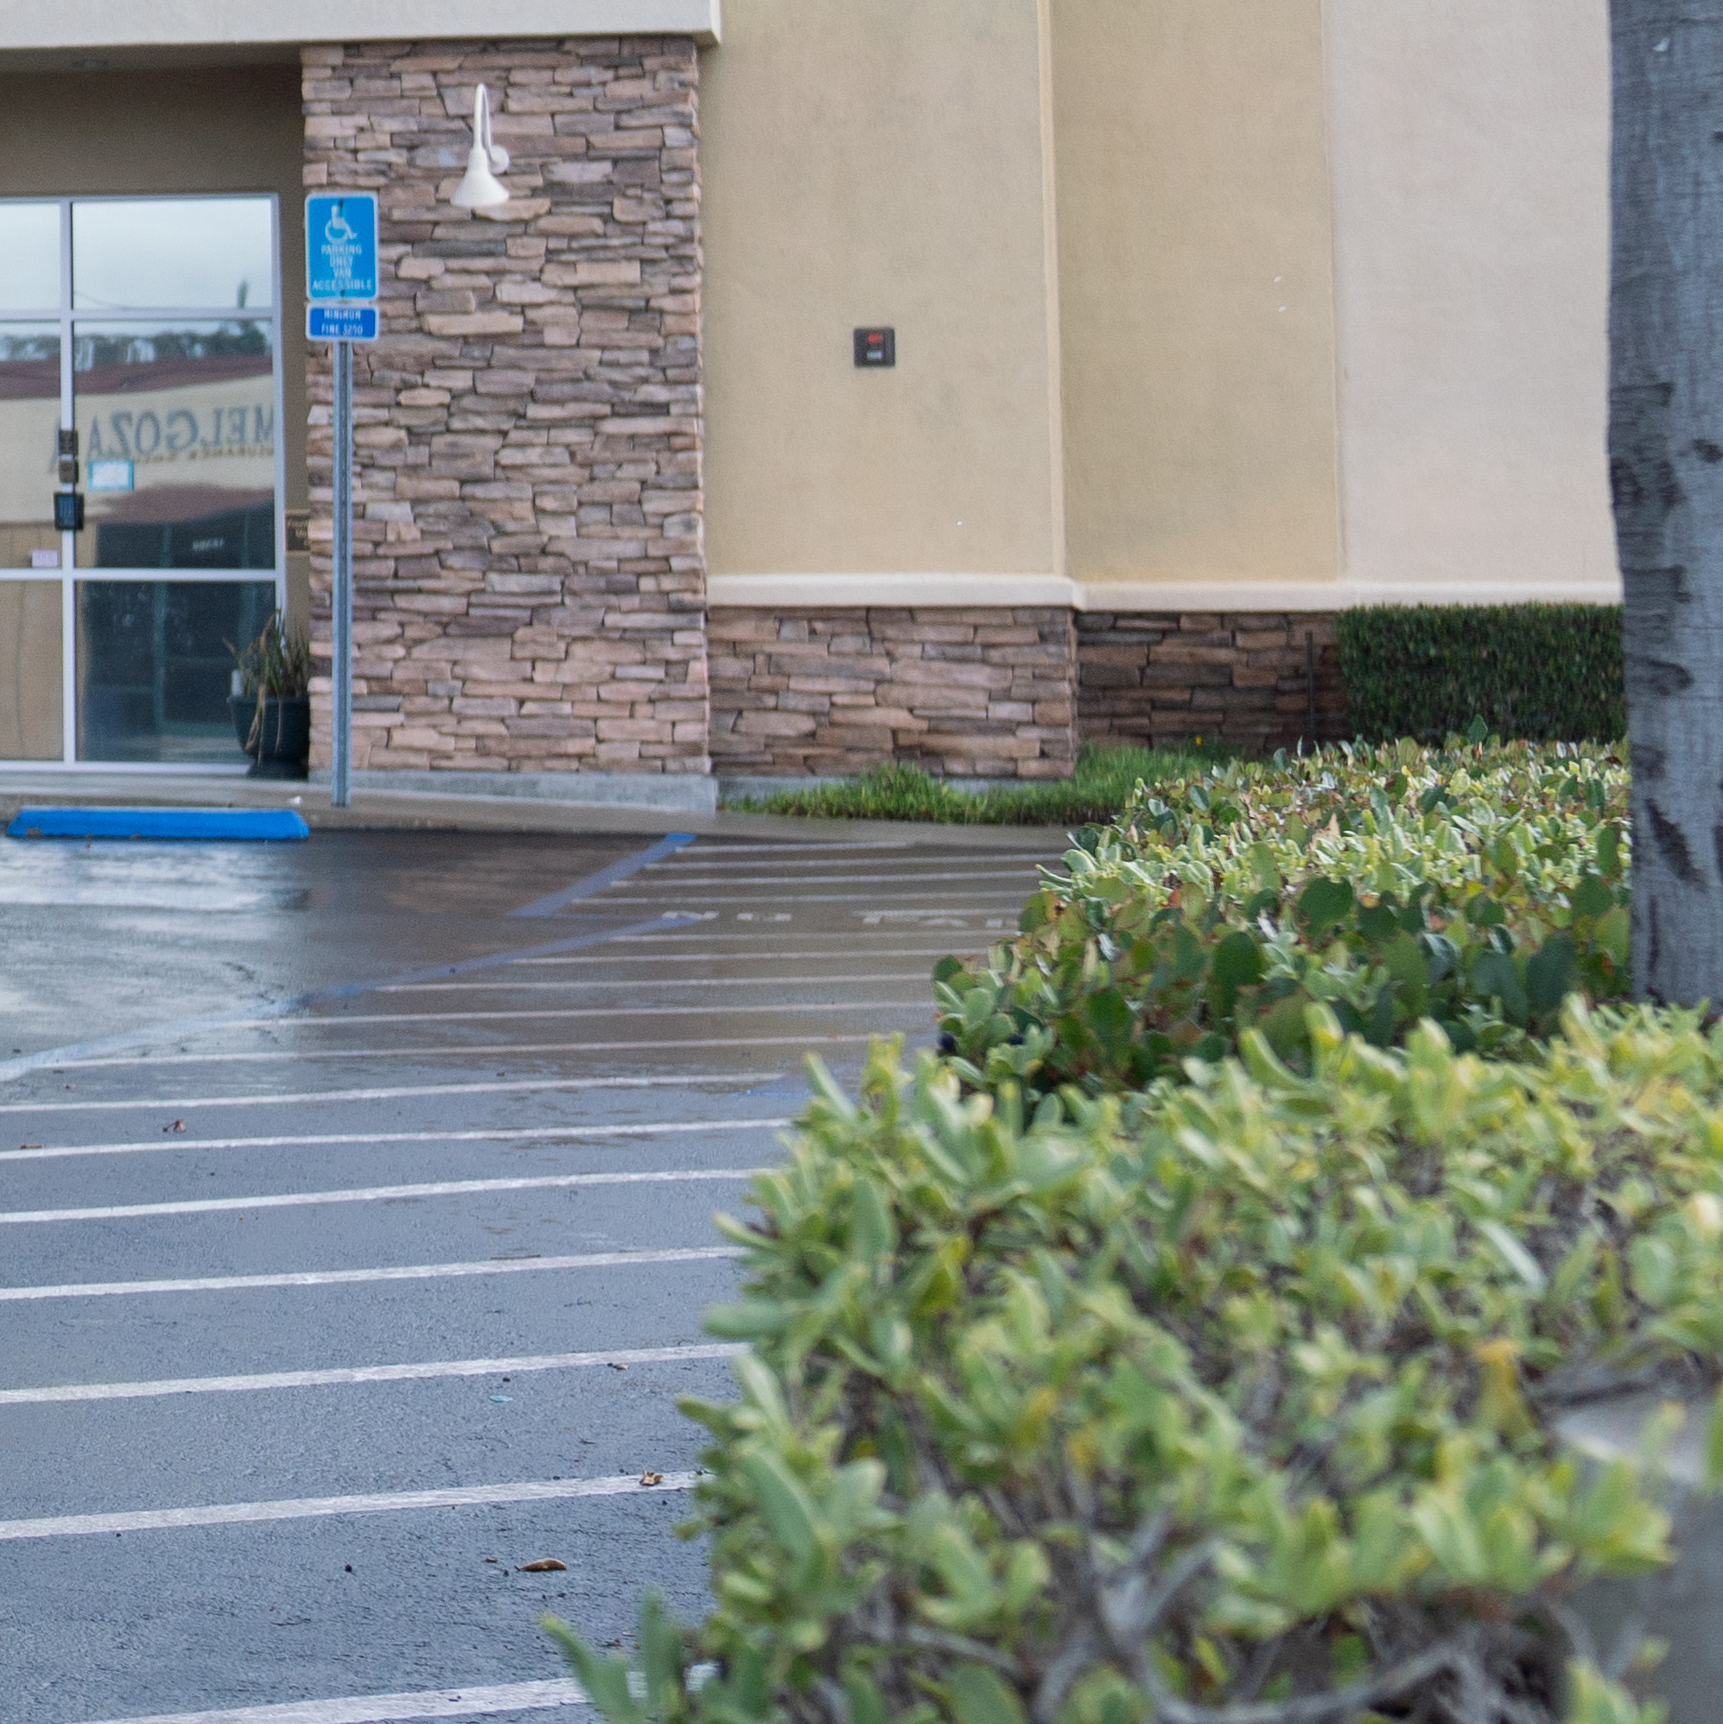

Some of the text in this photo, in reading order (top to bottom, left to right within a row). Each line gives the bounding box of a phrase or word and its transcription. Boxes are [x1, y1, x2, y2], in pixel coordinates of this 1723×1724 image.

[321, 244, 362, 255] PARKING
[329, 255, 354, 267] ONLY
[312, 279, 372, 291] ACCESSIBLE
[323, 309, 361, 320] MINIMUM
[321, 324, 339, 336] FINE
